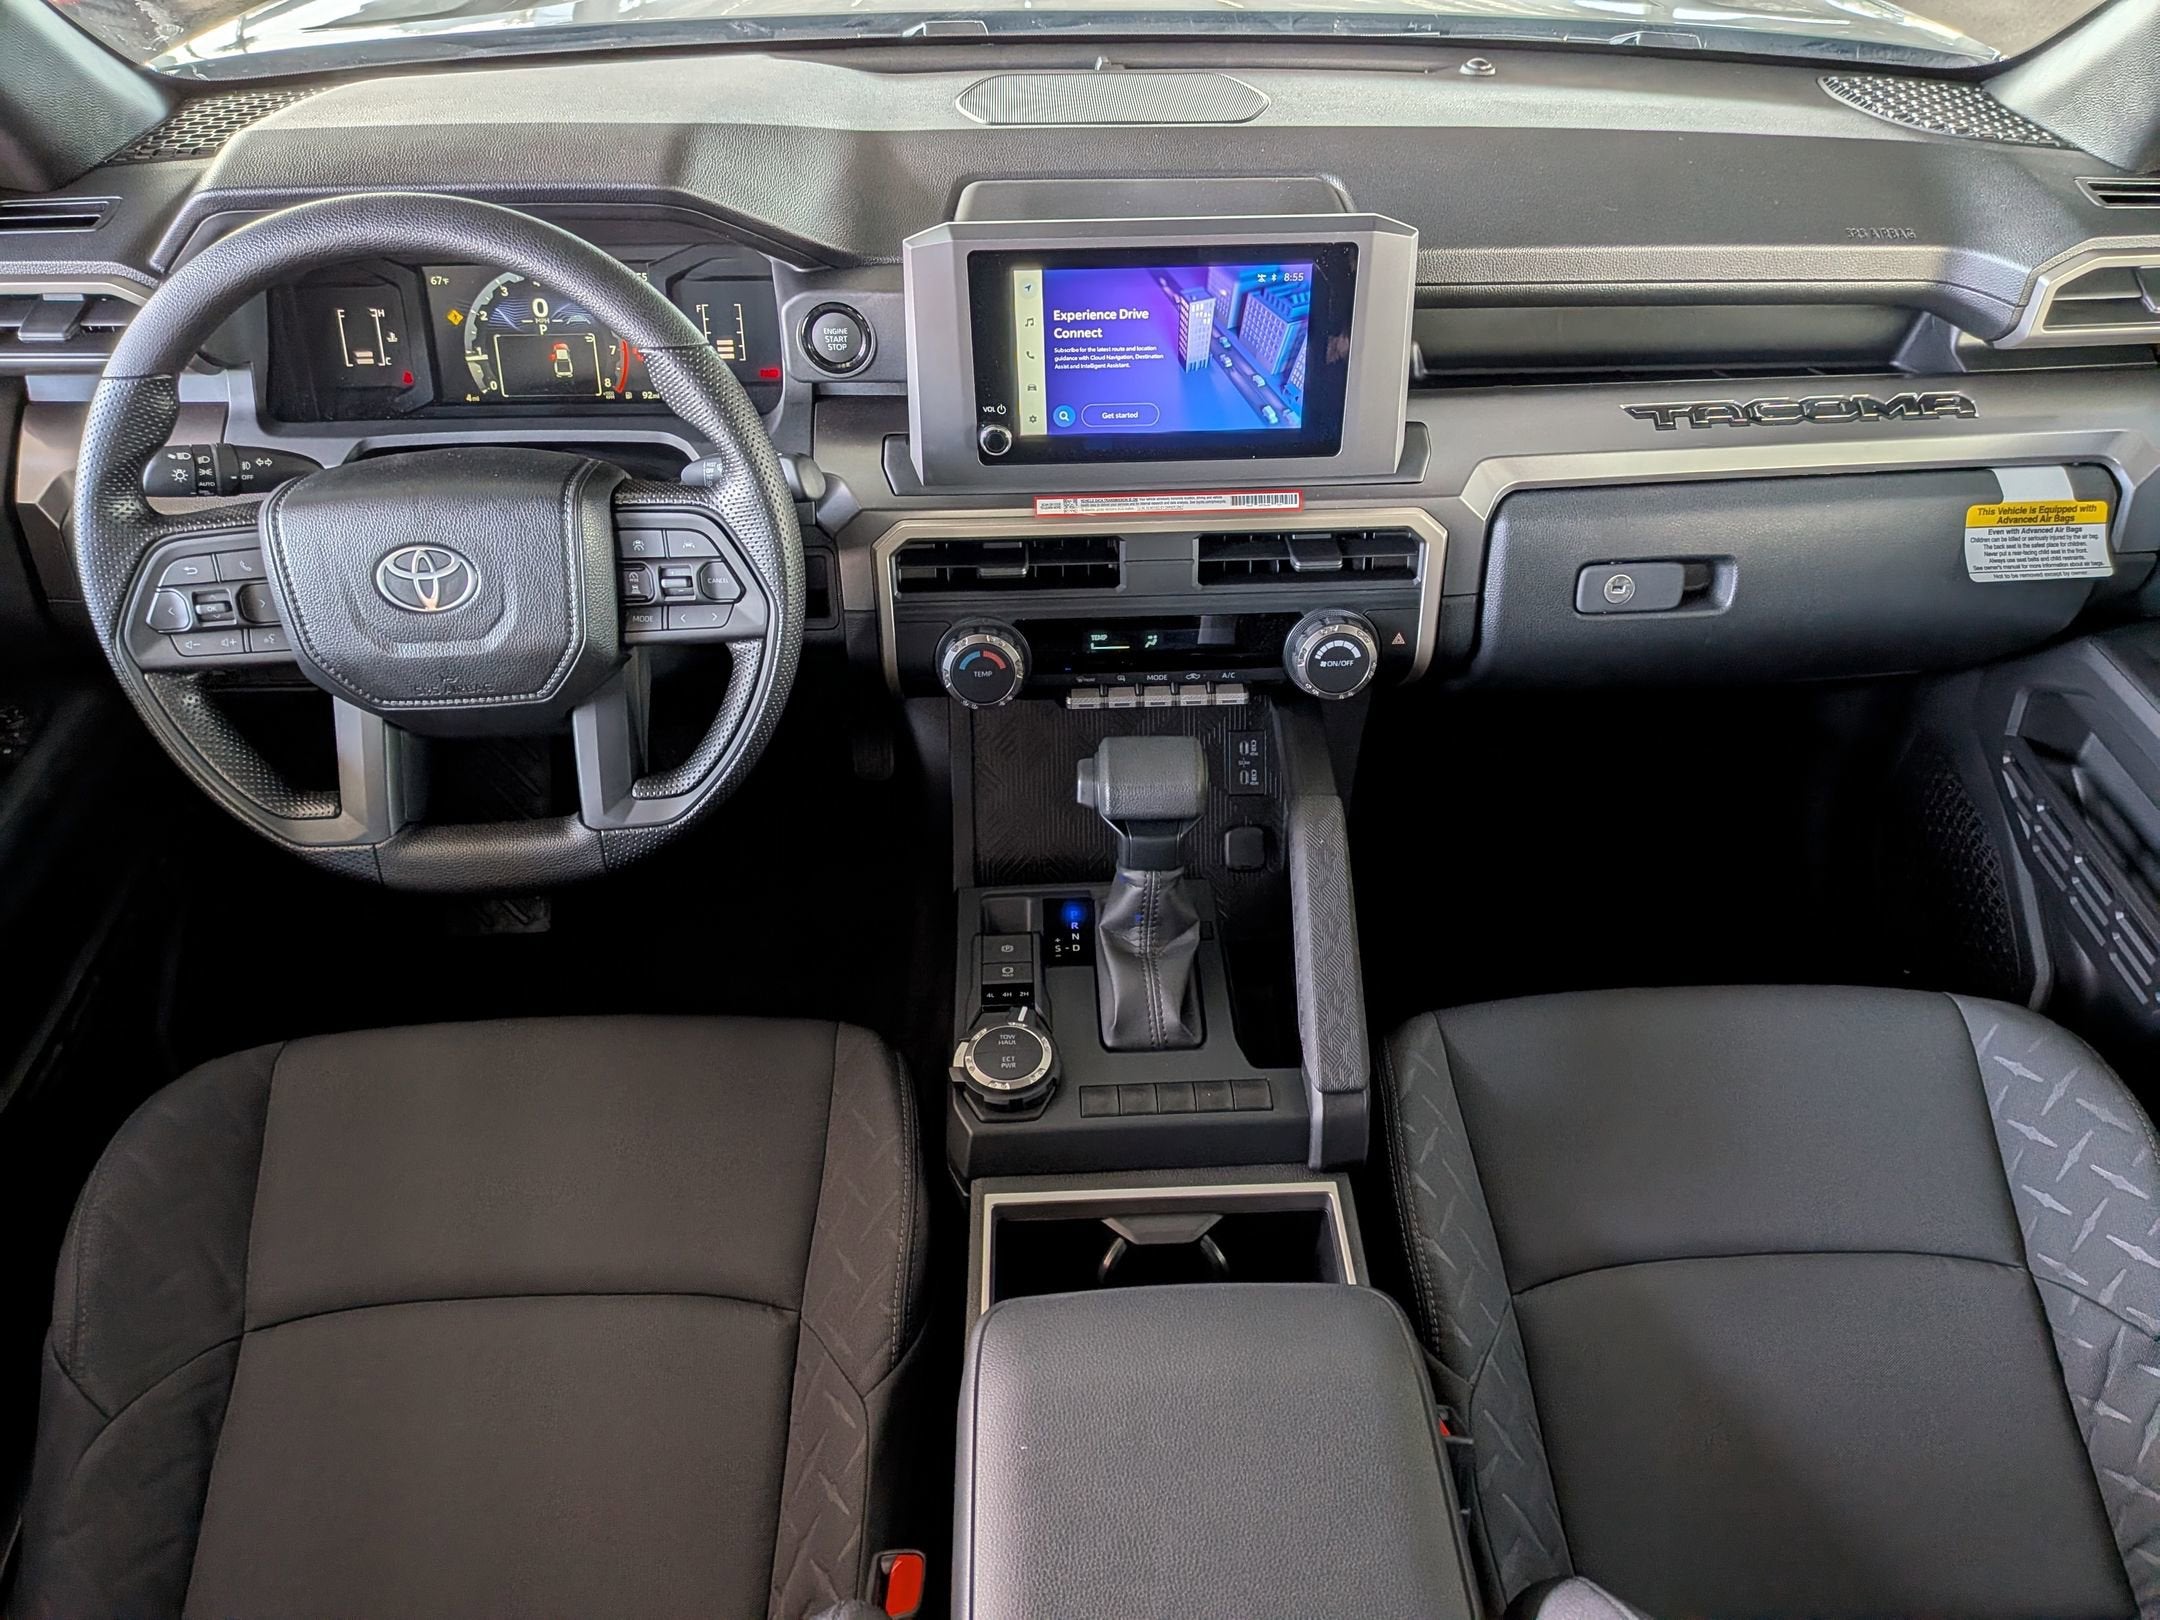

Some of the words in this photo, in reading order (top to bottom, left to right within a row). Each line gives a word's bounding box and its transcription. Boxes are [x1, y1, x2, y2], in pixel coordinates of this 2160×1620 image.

[1284, 272, 1304, 282] 8:55
[500, 286, 508, 296] 3
[532, 298, 549, 318] 0
[378, 309, 385, 318] H
[480, 310, 488, 320] 2
[1053, 309, 1117, 323] Experience
[1119, 308, 1150, 320] Drive
[540, 324, 548, 335] P
[824, 328, 848, 336] ENGINE
[1054, 328, 1103, 338] Connect
[608, 345, 616, 355] 7
[490, 380, 498, 390] 0
[604, 378, 612, 388] 8
[1116, 410, 1138, 418] started
[1619, 392, 1979, 431] TACOMA
[1978, 508, 1995, 516] This
[1998, 506, 2027, 515] Vehicle
[2039, 504, 2078, 515] Equipped
[2080, 504, 2097, 512] with
[1996, 515, 2038, 524] Advanced
[2040, 514, 2052, 523] Air
[2054, 514, 2075, 524] Bags
[1327, 660, 1354, 668] ON/OFF
[1070, 910, 1078, 920] P
[1072, 932, 1080, 940] N
[1055, 944, 1062, 952] S
